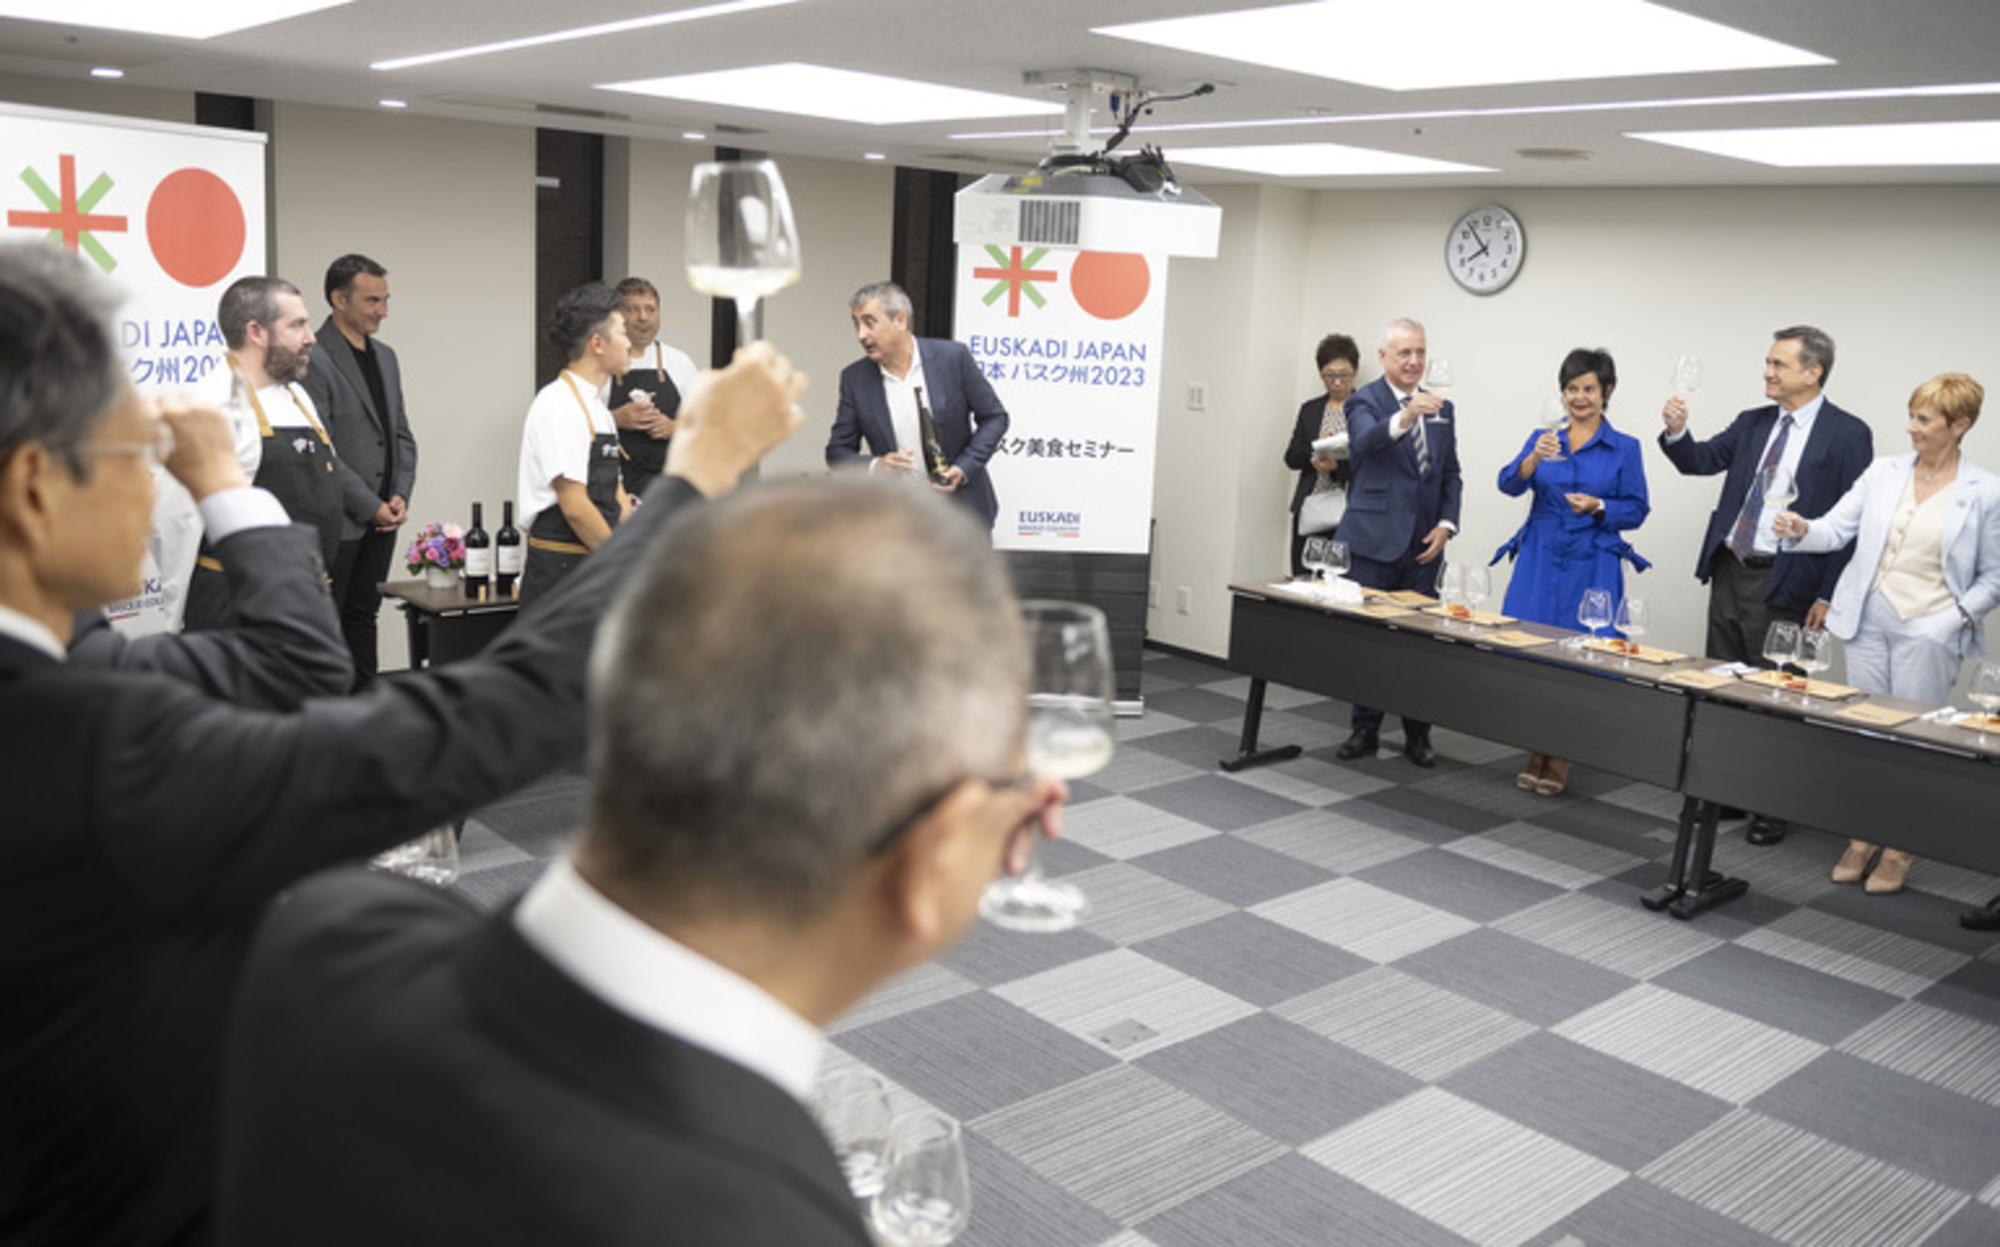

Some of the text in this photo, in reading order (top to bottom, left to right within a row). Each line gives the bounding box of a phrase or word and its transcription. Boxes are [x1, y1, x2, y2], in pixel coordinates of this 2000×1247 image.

[160, 319, 224, 348] JAPA
[969, 335, 1147, 362] EUSKADI JAPAN
[998, 437, 1135, 459] スク美食セミナー
